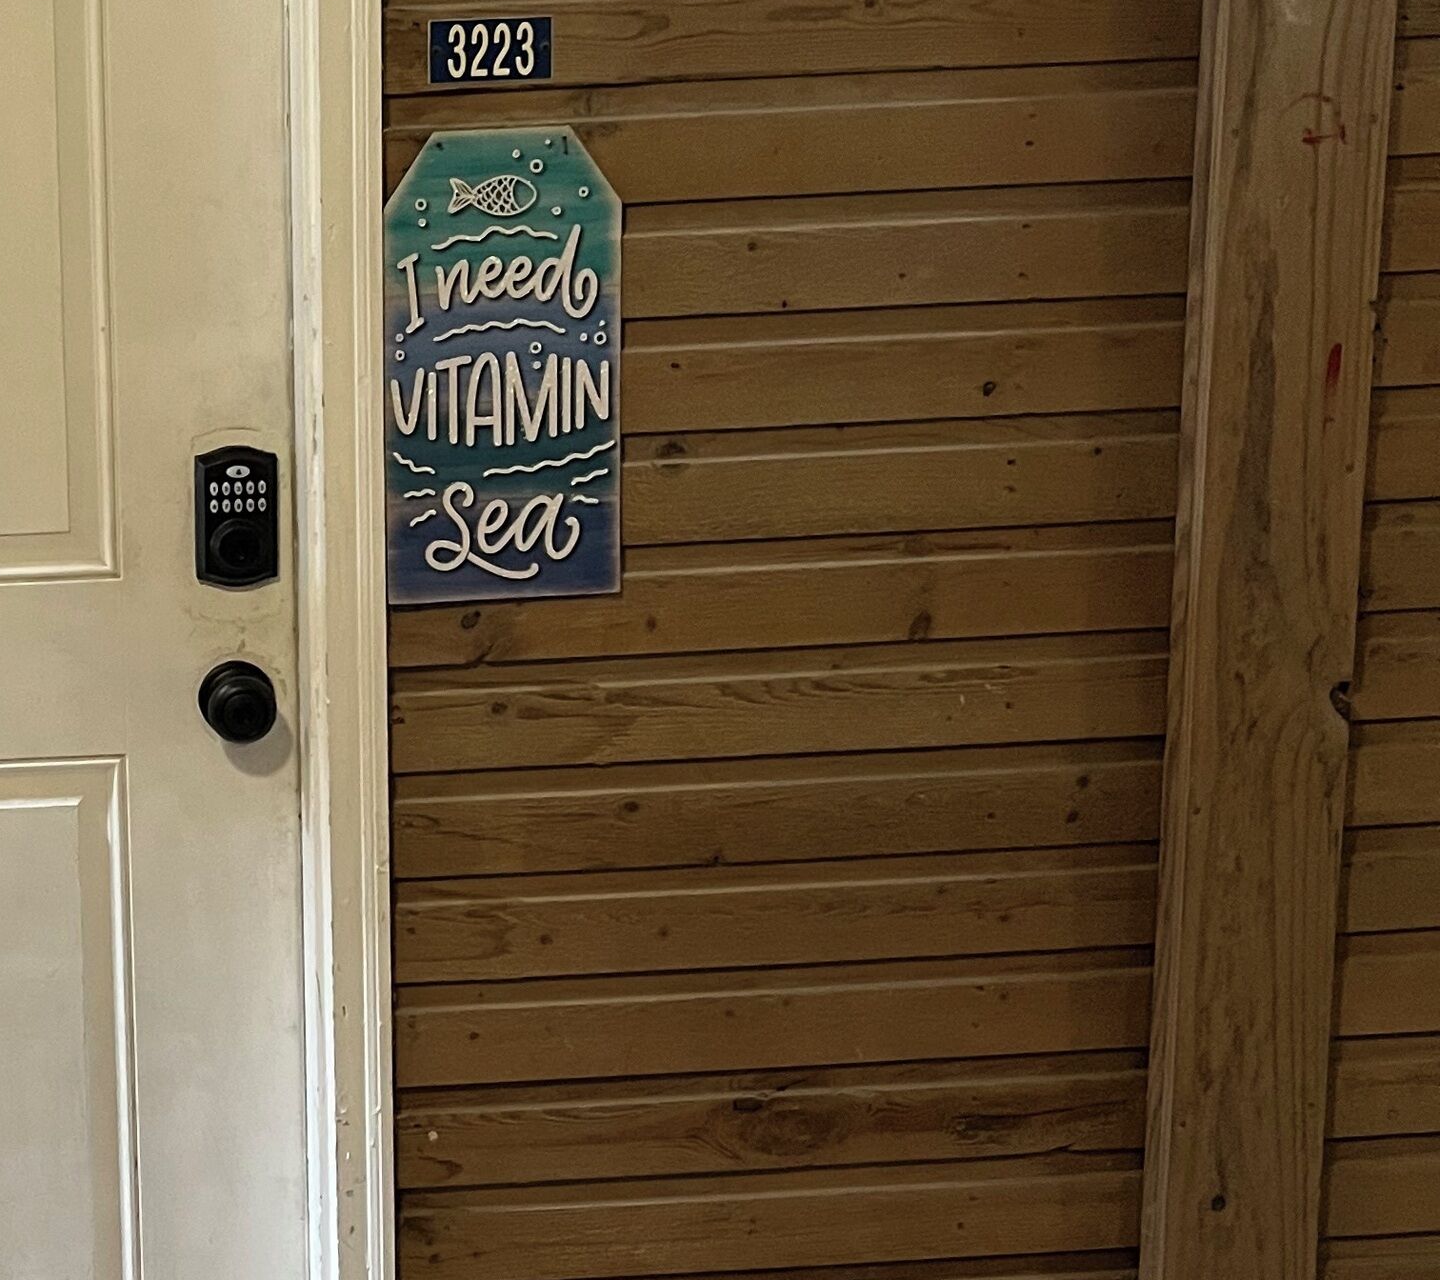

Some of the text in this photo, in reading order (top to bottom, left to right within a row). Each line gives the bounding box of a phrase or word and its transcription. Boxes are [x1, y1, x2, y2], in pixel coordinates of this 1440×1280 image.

[446, 23, 535, 78] 3223
[397, 224, 598, 334] I need
[391, 351, 609, 447] VITAMIN
[425, 481, 580, 579] Sea
